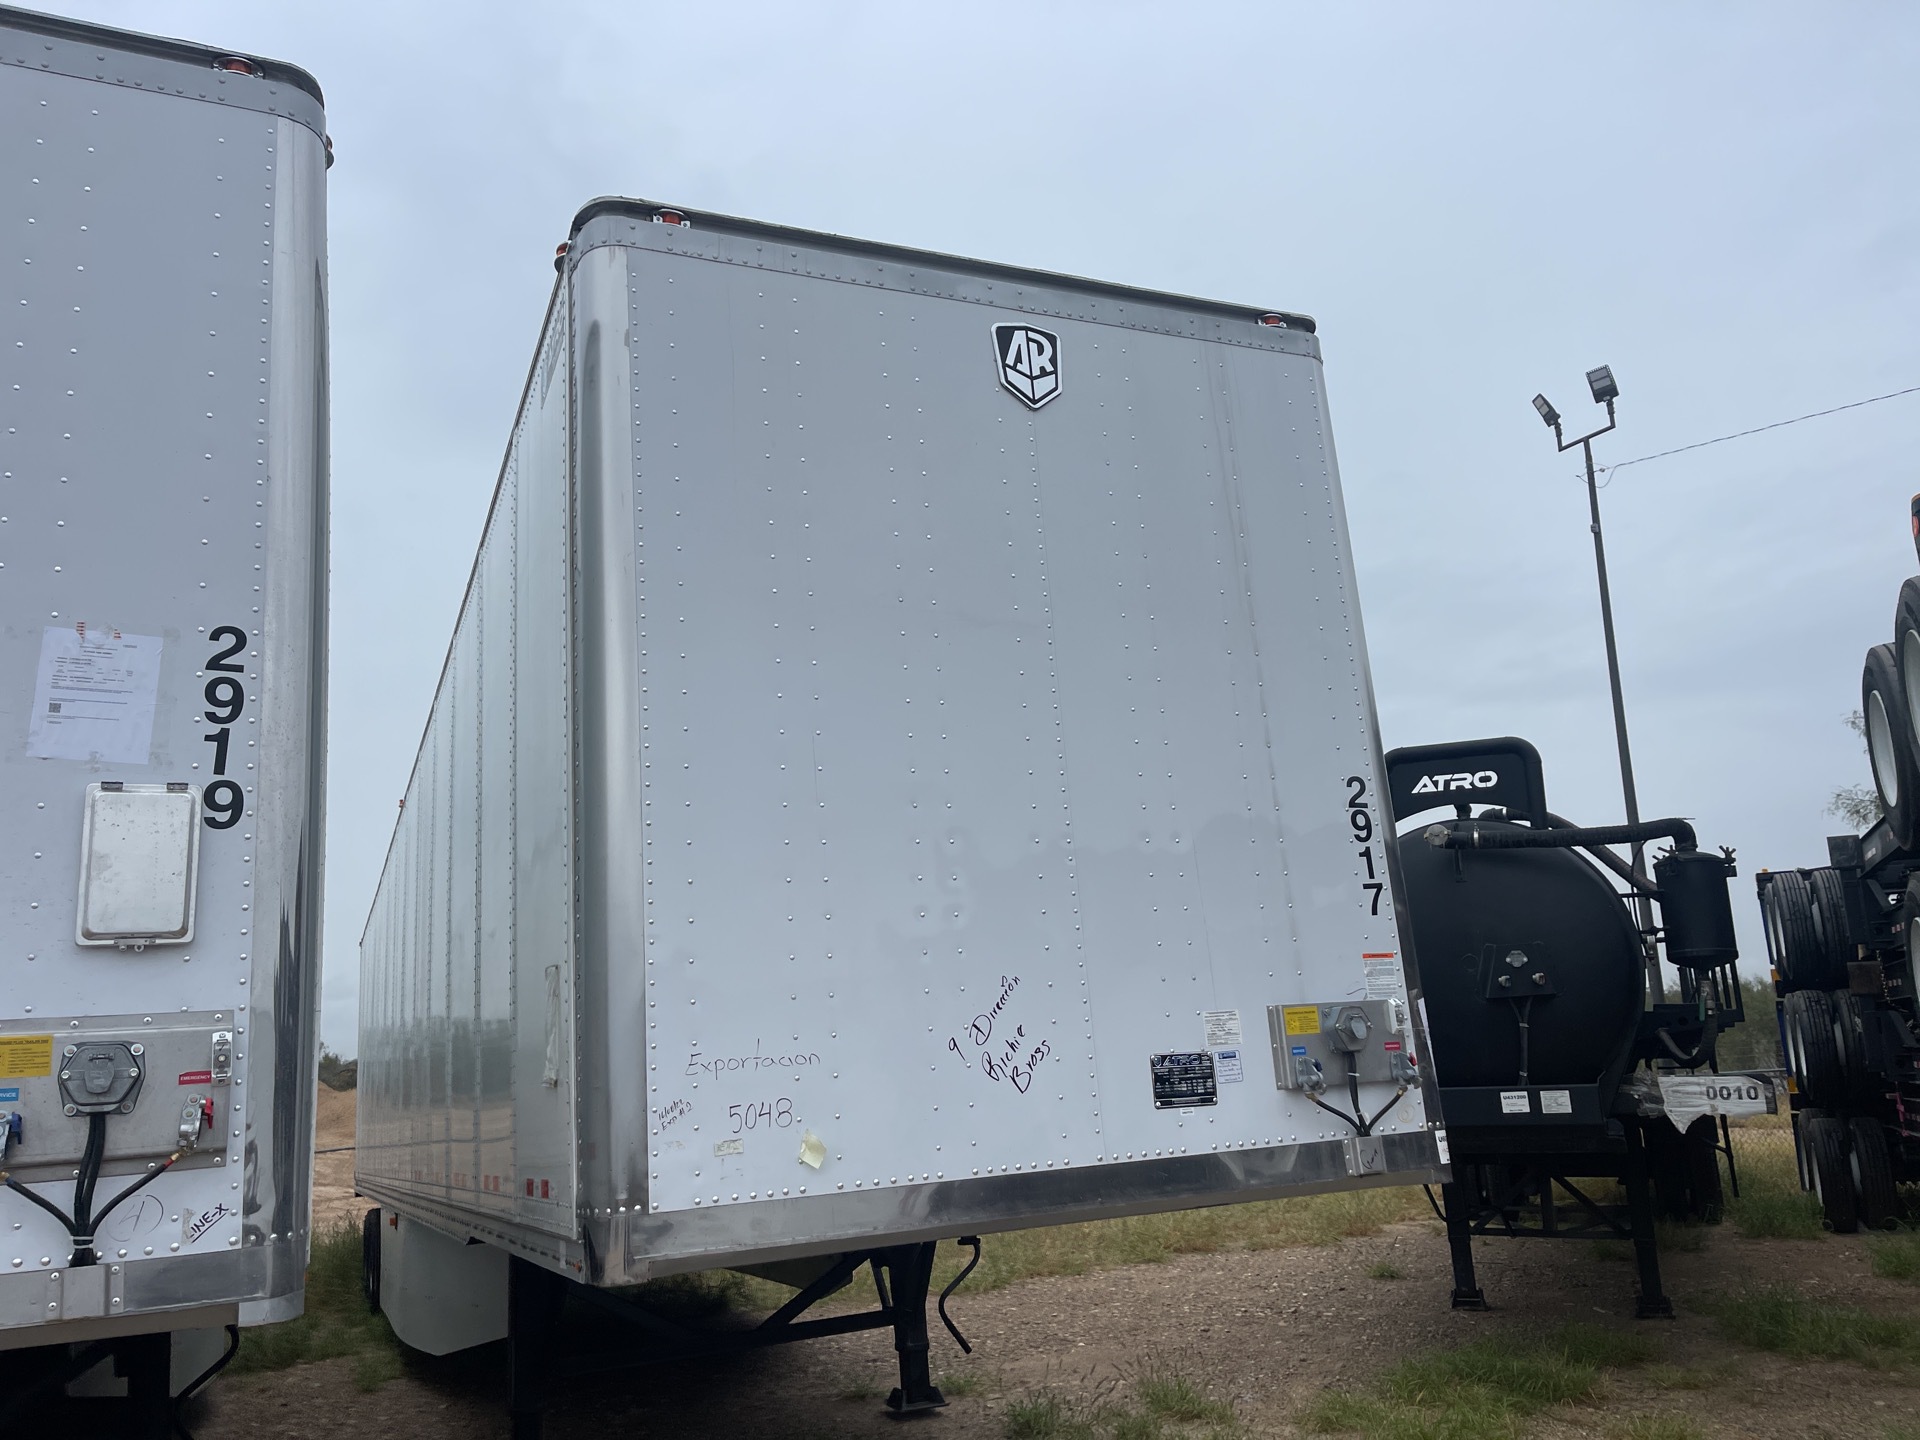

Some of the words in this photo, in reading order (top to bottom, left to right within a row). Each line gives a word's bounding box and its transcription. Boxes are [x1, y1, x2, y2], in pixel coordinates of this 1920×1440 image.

[202, 625, 248, 830] 2919
[1411, 770, 1498, 794] ATRO
[1346, 775, 1384, 916] 2917
[1162, 1054, 1201, 1066] ATRO
[1705, 1085, 1760, 1101] 0010
[729, 1097, 793, 1134] 5048
